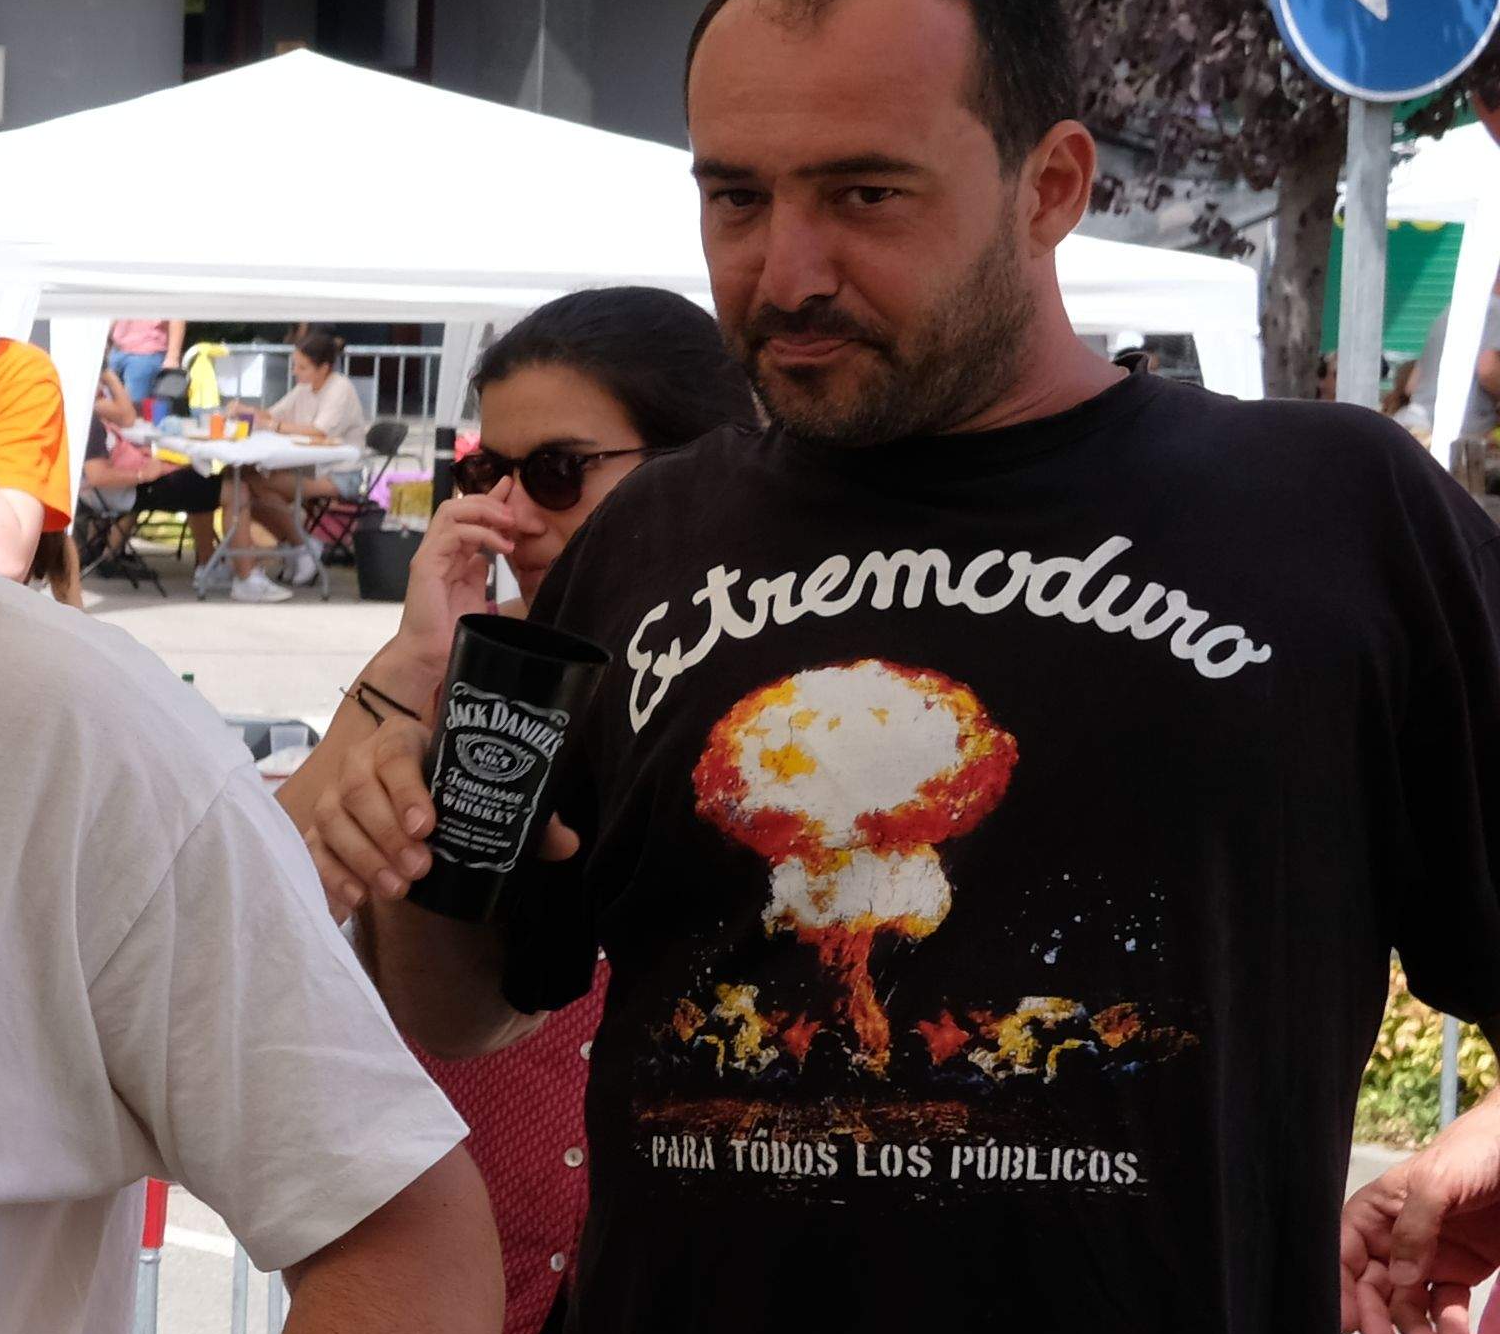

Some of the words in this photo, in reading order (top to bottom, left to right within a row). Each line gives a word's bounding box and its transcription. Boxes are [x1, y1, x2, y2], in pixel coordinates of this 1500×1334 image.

[627, 535, 1272, 734] Extremoduro
[445, 698, 489, 730] JACK
[490, 701, 565, 759] DANIEL'S
[442, 793, 518, 825] WHISKEY
[651, 1133, 716, 1170] PARA
[856, 1139, 933, 1179] LOS
[950, 1136, 1140, 1185] PÚBLICOS
